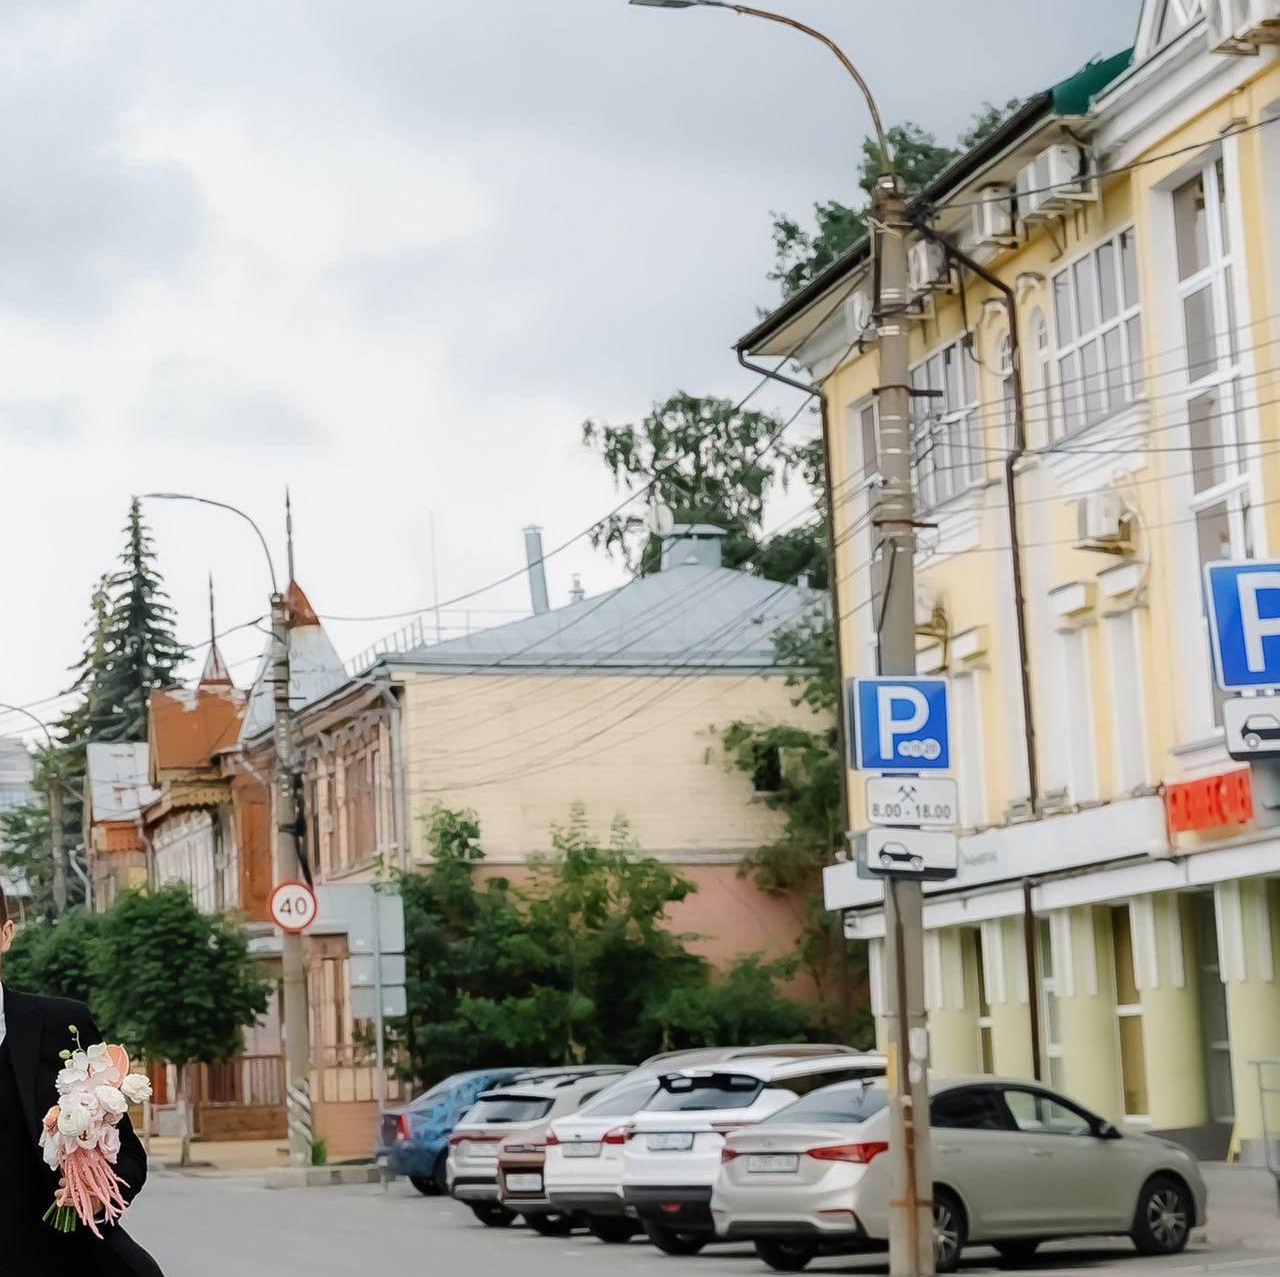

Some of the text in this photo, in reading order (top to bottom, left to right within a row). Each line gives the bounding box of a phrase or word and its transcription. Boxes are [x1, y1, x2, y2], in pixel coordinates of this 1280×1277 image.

[877, 686, 930, 760] P
[872, 803, 901, 818] 8.00
[915, 804, 952, 819] 18.00
[280, 897, 308, 916] 40
